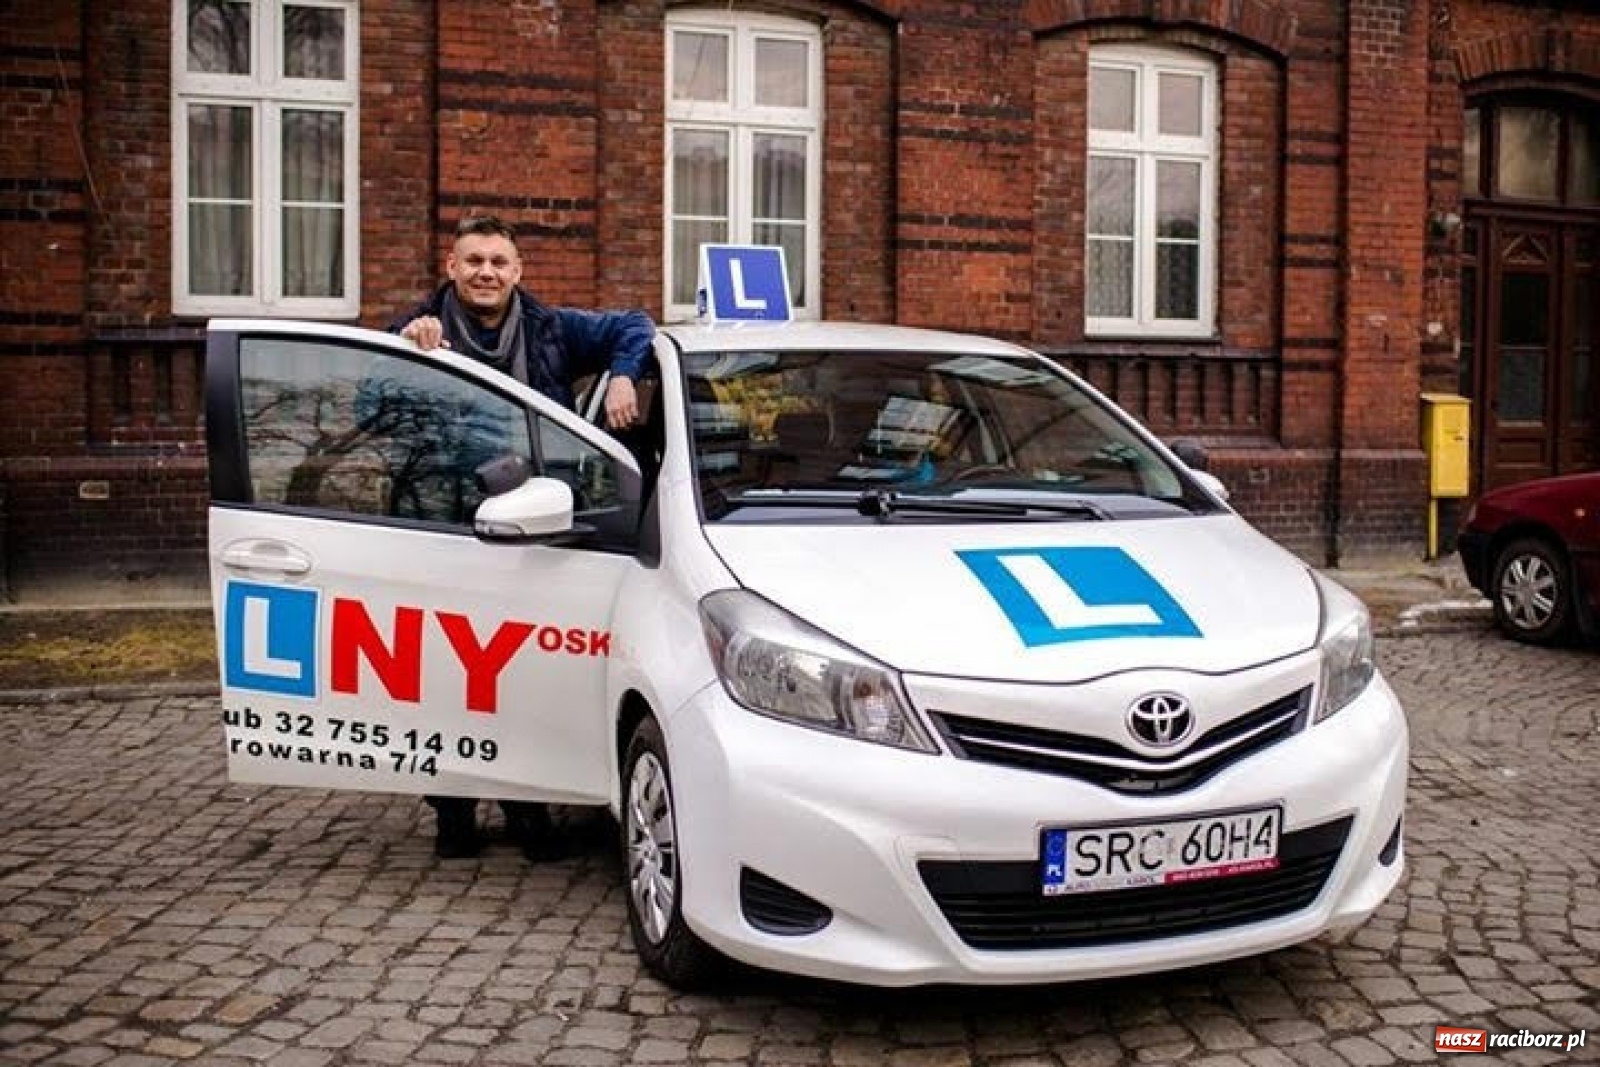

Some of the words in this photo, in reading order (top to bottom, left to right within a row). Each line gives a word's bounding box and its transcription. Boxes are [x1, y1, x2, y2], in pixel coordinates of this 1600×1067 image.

[729, 258, 768, 309] L
[996, 555, 1164, 629] L
[223, 707, 262, 729] ub
[275, 711, 314, 738] 32
[327, 717, 390, 747] 755
[404, 729, 444, 754] 14
[457, 736, 499, 762] 09
[230, 738, 376, 769] rowarna
[389, 751, 439, 776] 7/4
[1075, 830, 1166, 876] SRC
[1181, 815, 1274, 866] 60H4
